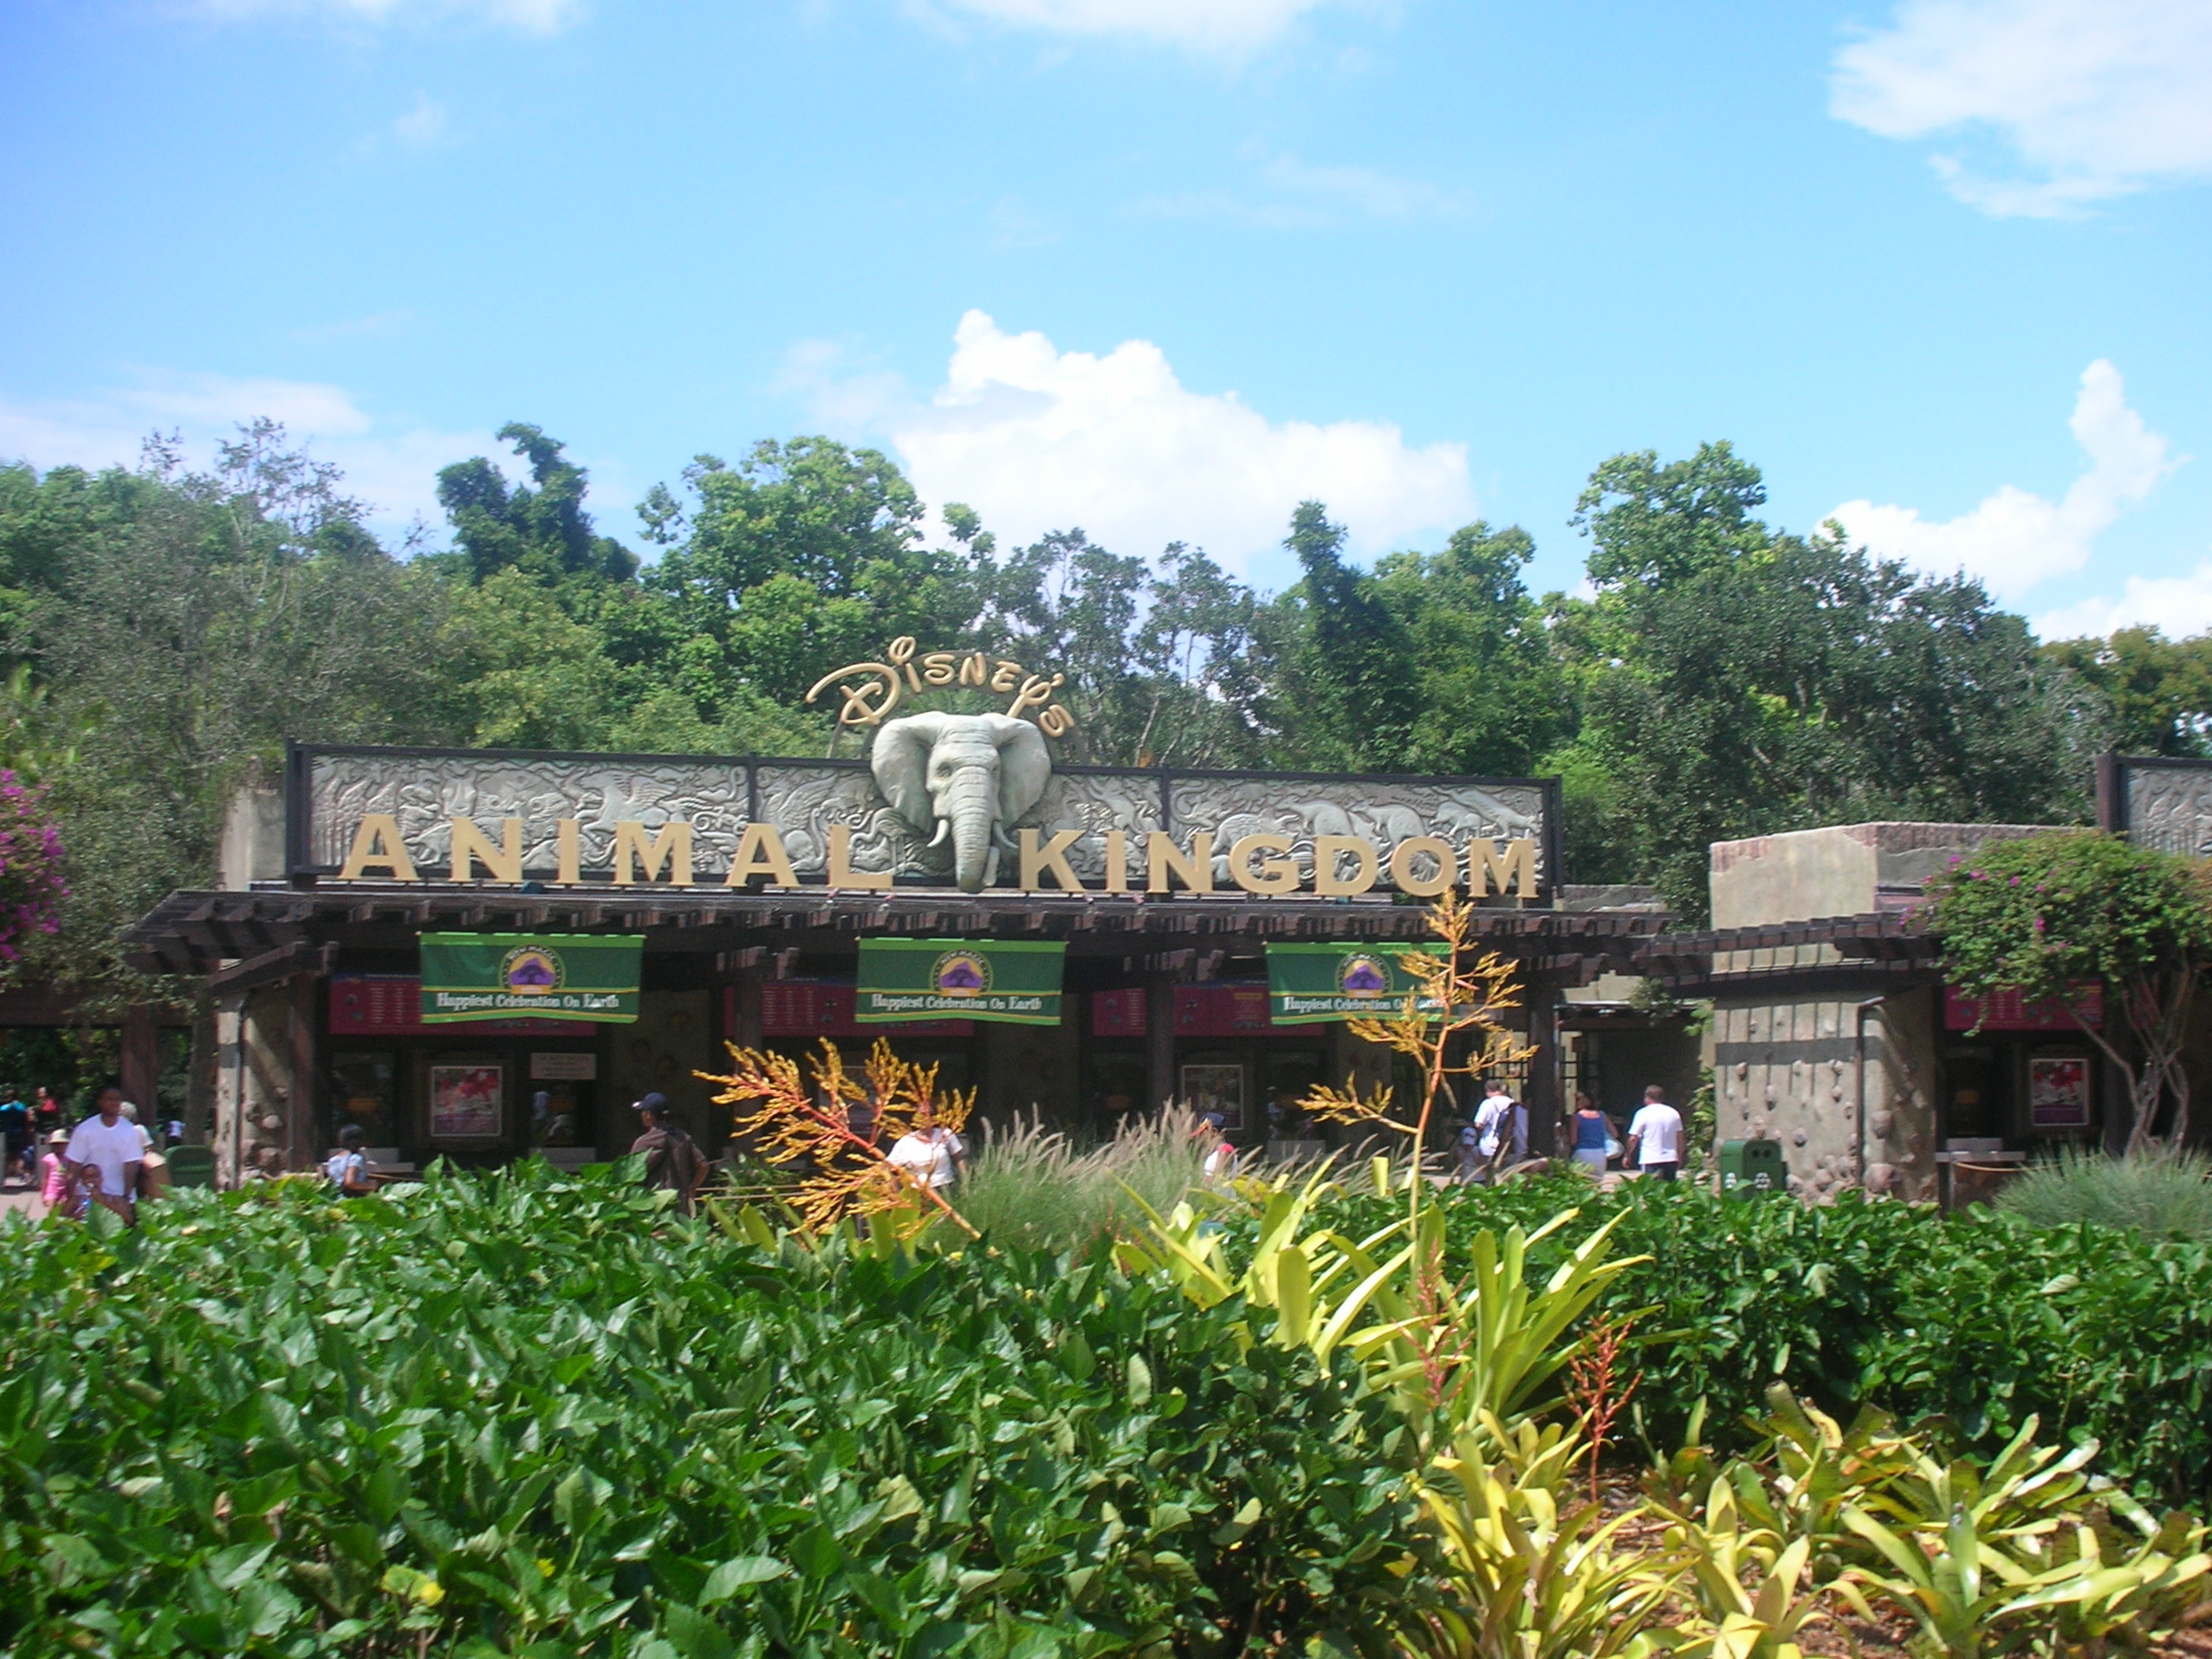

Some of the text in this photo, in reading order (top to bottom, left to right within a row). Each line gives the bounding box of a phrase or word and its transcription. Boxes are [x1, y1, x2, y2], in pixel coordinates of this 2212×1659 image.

[339, 814, 1540, 899] ANIMAL KINGDOM
[437, 992, 619, 1011] Happiest Celebration On Earth
[871, 994, 1042, 1011] Happiest Celebration On Earth
[1283, 996, 1332, 1014] Happiest
[1334, 998, 1391, 1011] Celebration
